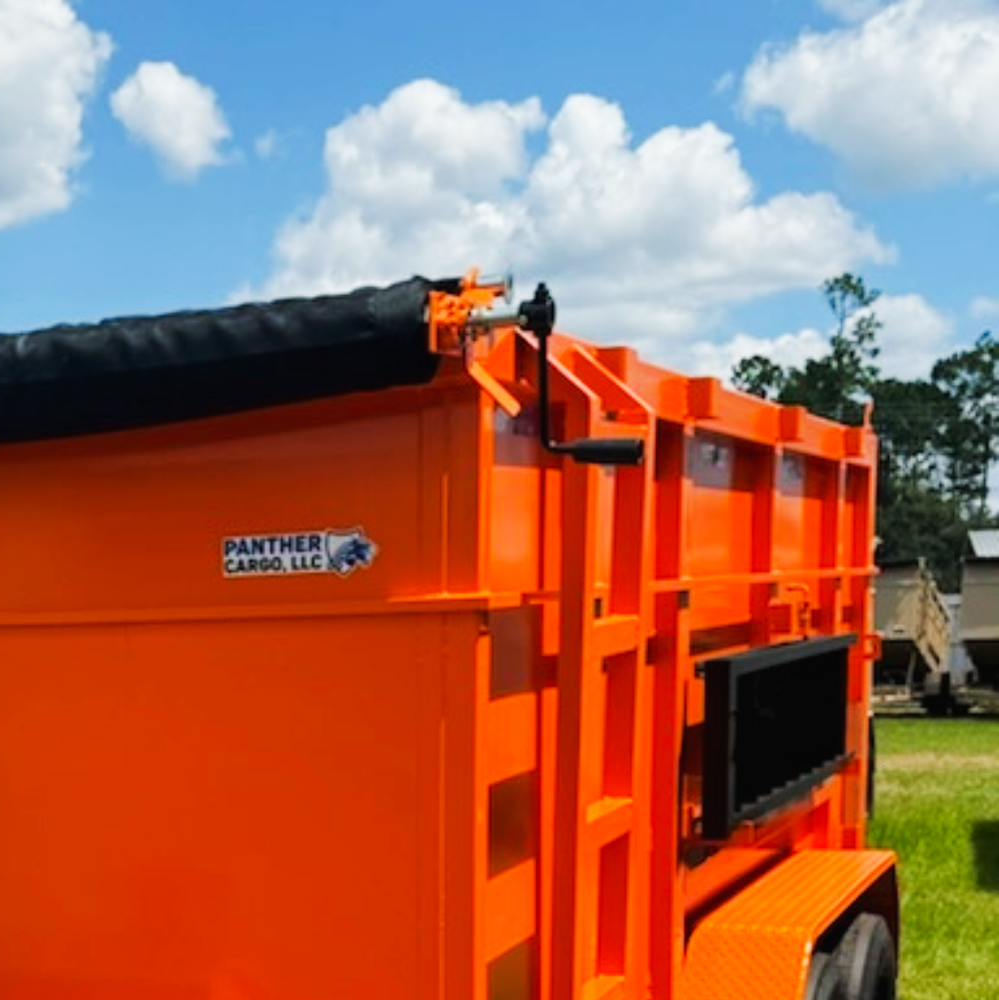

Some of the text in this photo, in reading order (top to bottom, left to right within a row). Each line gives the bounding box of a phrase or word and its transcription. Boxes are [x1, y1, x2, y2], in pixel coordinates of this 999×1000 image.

[224, 535, 322, 555] PANTHER
[224, 554, 323, 573] CARGO, LLC
